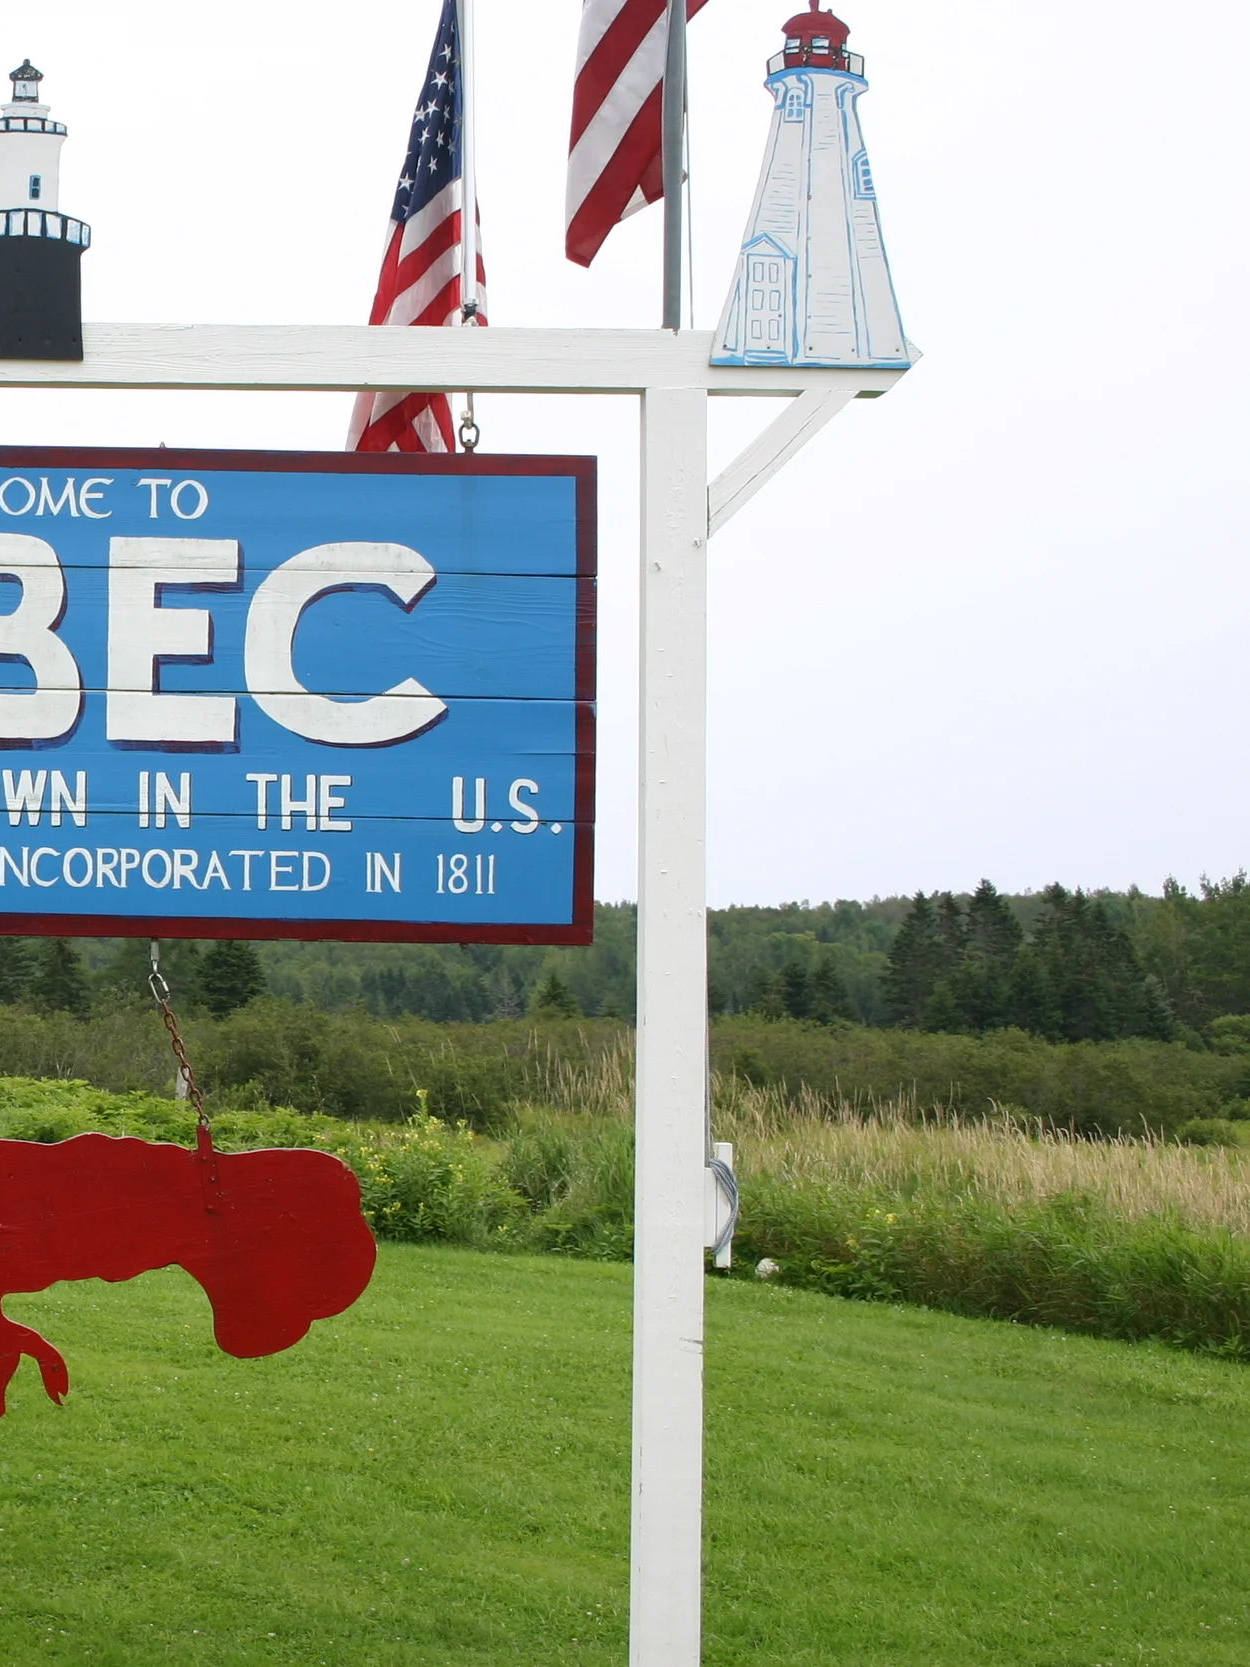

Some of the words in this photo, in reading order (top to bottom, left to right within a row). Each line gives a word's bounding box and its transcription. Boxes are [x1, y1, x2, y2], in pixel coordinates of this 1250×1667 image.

[137, 478, 209, 520] TO
[139, 771, 190, 828] IN
[245, 773, 352, 831] THE
[452, 776, 562, 834] U.S.
[366, 852, 401, 893] IN
[437, 853, 495, 894] 1811
